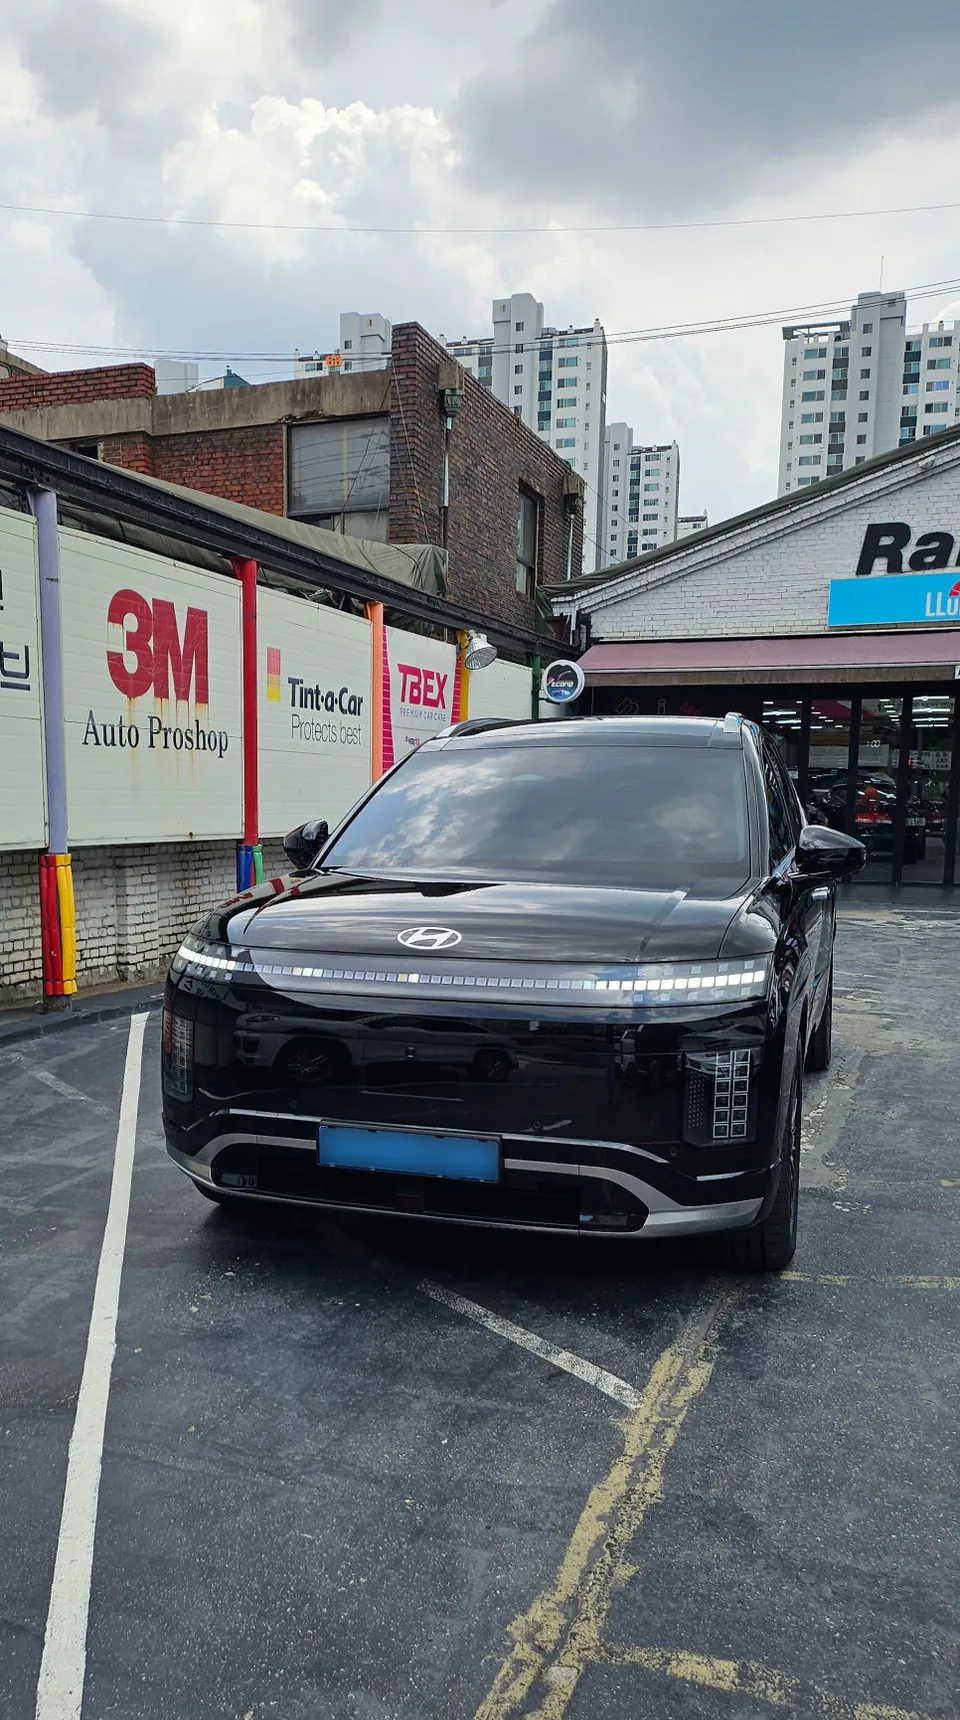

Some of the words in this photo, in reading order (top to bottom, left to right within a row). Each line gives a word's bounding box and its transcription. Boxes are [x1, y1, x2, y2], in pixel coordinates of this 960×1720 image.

[856, 522, 960, 576] Ra
[106, 589, 209, 704] 3M
[397, 663, 448, 710] TBEX
[81, 709, 140, 748] Auto
[147, 715, 229, 759] Proshop
[291, 713, 338, 743] Protects
[340, 720, 362, 745] best
